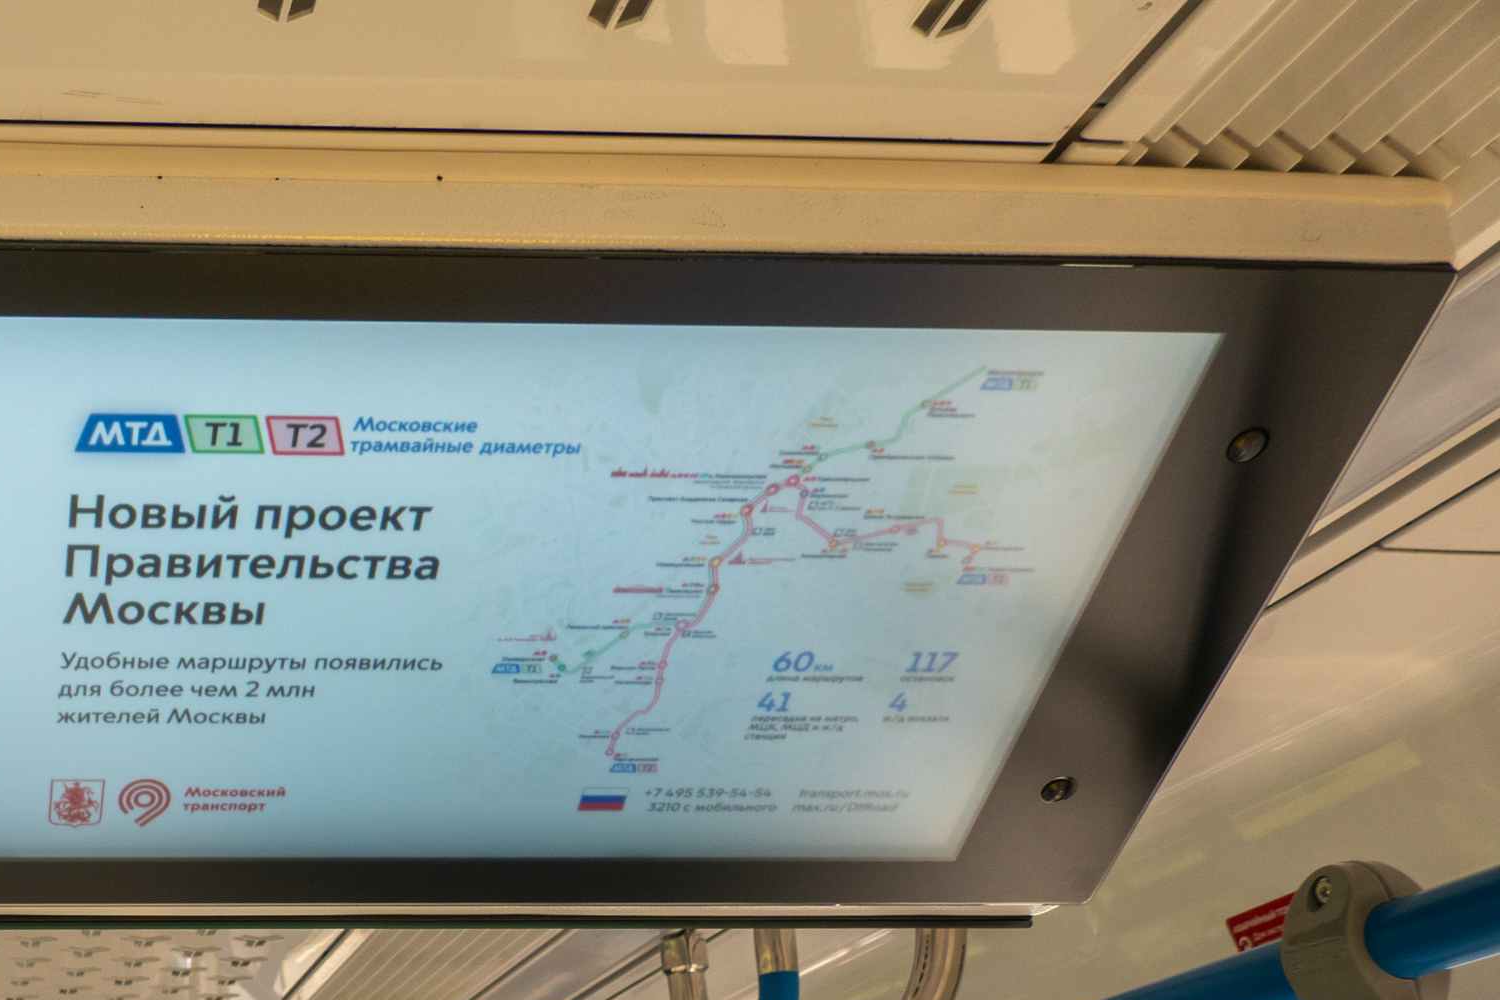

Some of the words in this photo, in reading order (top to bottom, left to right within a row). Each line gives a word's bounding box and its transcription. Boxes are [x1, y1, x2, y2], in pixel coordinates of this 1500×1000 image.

[86, 421, 173, 446] МТД
[204, 421, 244, 447] Т1
[285, 423, 328, 448] Т2
[353, 417, 478, 434] Московские
[350, 438, 473, 455] трамвайные
[479, 440, 581, 456] диаметры
[67, 493, 238, 530] Новый
[254, 504, 432, 538] проект
[64, 544, 441, 585] Правительства
[62, 592, 266, 626] Москвы
[60, 652, 171, 673] Удобные
[177, 656, 307, 673] маршруты
[314, 656, 443, 672] появились
[771, 651, 815, 673] 60
[905, 651, 959, 673] 117
[58, 683, 102, 699] для
[110, 679, 183, 698] более
[190, 683, 238, 698] чем
[245, 681, 260, 698] 2
[266, 684, 316, 698] млн
[765, 675, 800, 683] длина
[756, 691, 792, 713] 41
[888, 692, 908, 712] 4
[56, 708, 160, 725] жителей
[167, 709, 266, 725] Москвы
[185, 785, 286, 798] Московский
[664, 788, 693, 798] 495
[183, 801, 266, 813] транспорт
[647, 802, 681, 812] 3210
[693, 802, 777, 813] мобильного
